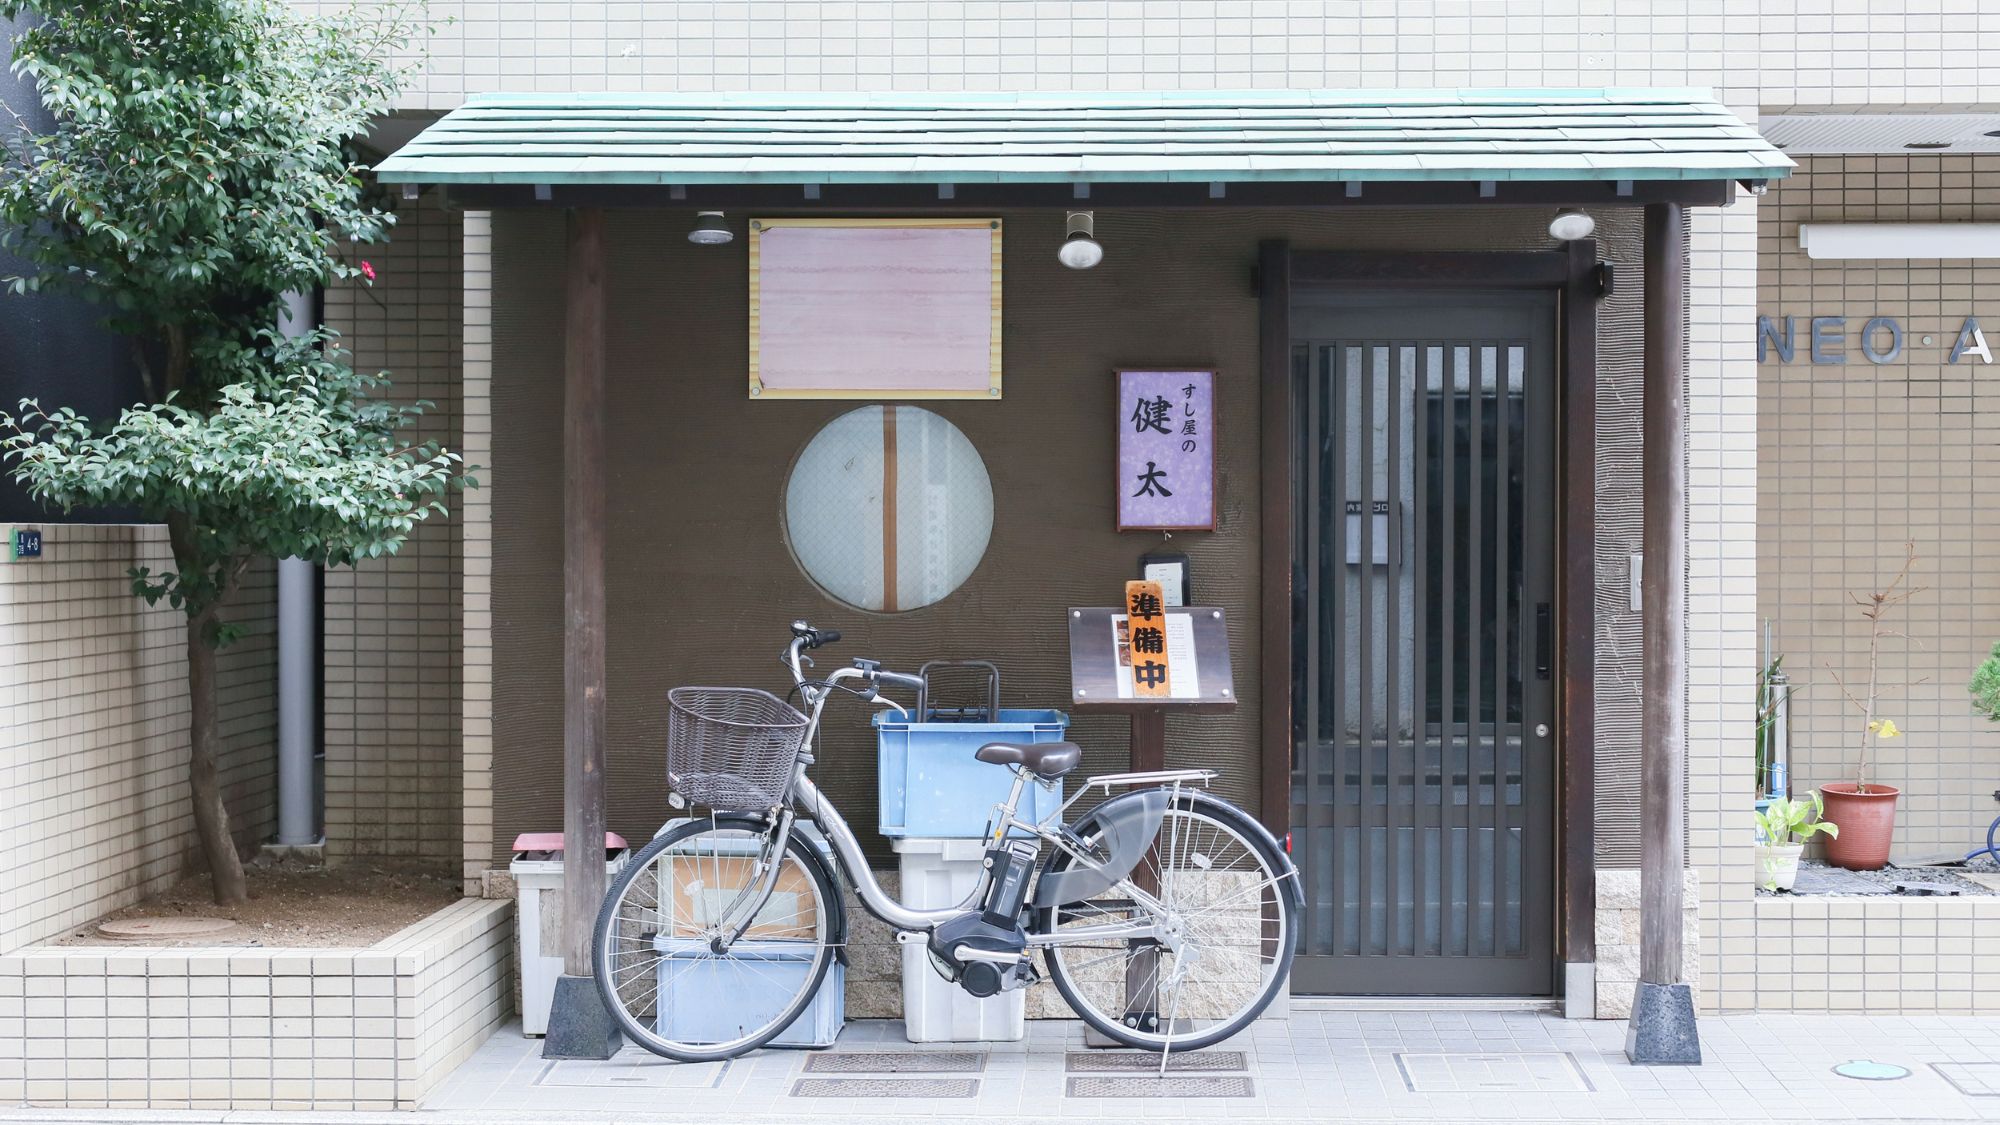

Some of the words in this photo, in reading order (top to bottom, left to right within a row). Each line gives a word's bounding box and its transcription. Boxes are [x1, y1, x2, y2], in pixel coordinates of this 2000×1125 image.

[1131, 395, 1173, 498] 健太
[1181, 383, 1197, 453] すし屋の
[27, 537, 39, 550] 4-8
[1131, 592, 1166, 689] 準備中
